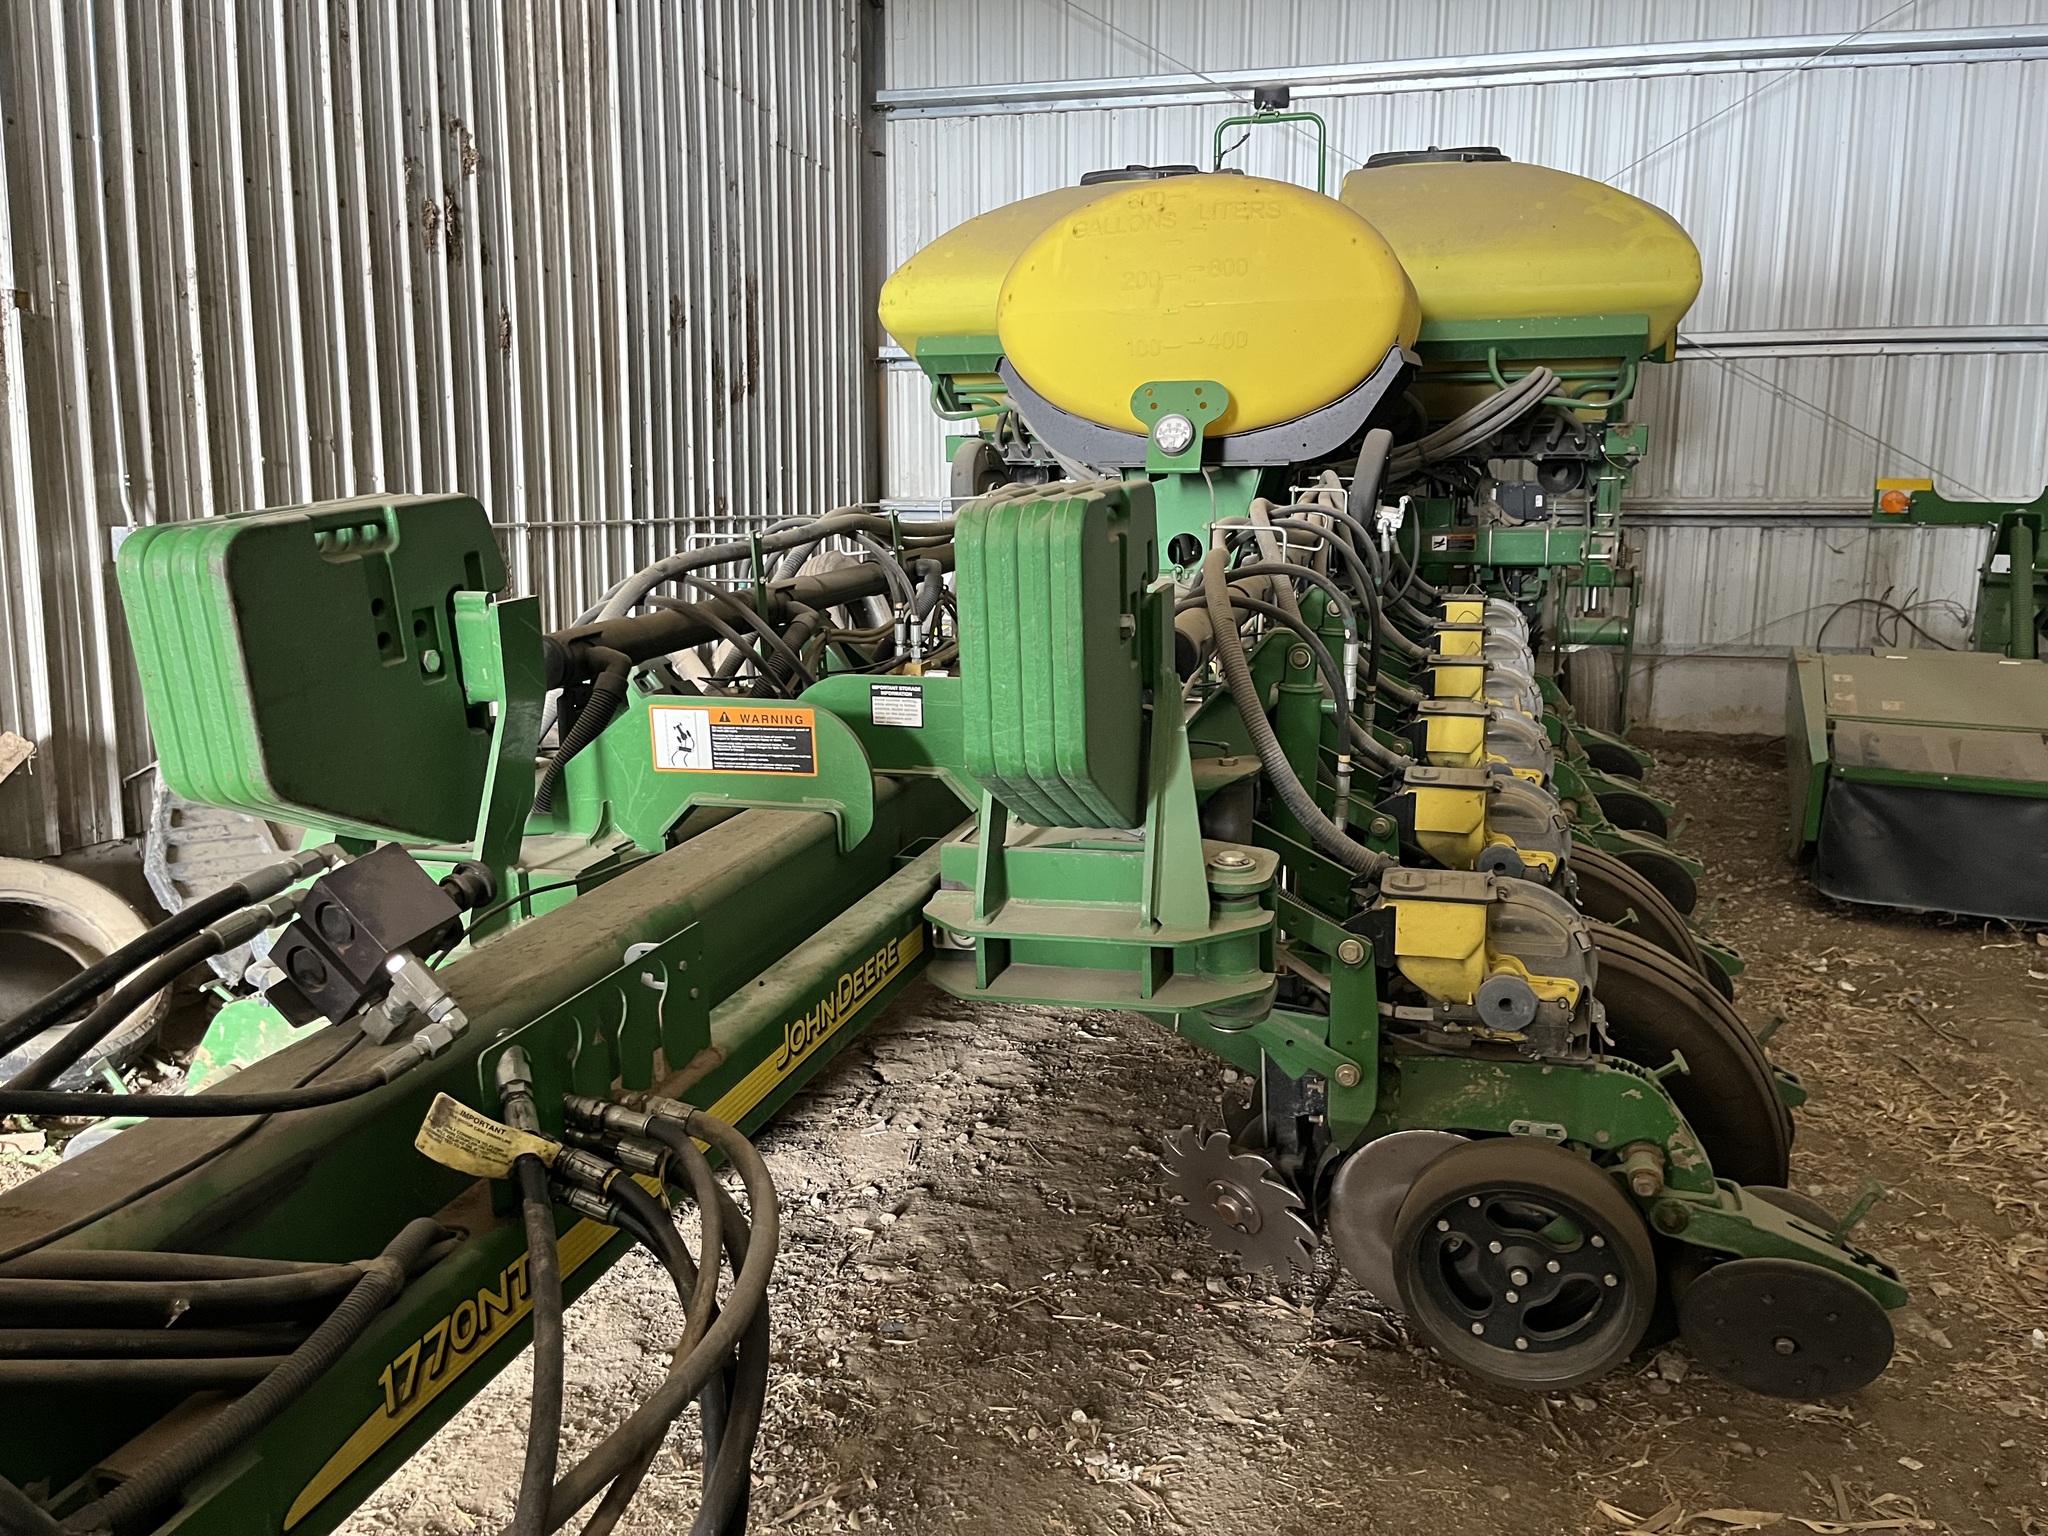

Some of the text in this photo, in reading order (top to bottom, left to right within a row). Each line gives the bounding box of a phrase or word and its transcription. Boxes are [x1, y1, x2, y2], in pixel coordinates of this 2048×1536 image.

[1072, 201, 1282, 239] GALLONS LITERS
[1121, 269, 1160, 291] 200
[1207, 330, 1248, 350] 400
[739, 713, 804, 725] WARNING
[776, 936, 900, 1072] JOHN DEERE
[459, 1109, 507, 1135] IMPORTANT
[377, 1256, 533, 1417] 1770NT
